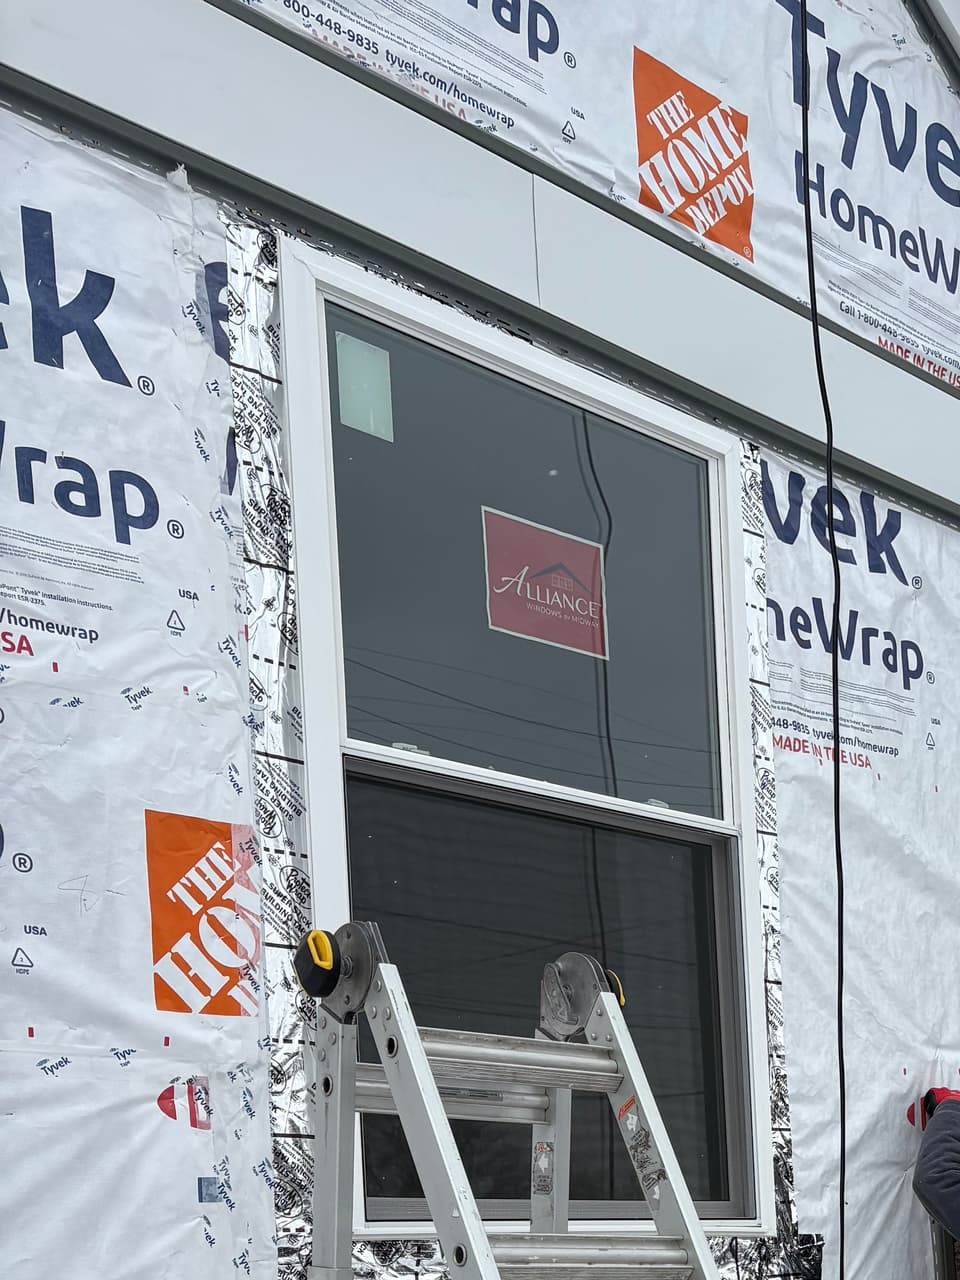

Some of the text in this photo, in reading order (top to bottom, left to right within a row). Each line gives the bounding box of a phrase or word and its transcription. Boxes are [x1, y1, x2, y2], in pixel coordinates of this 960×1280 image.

[385, 49, 515, 128] tyvek.com/homewrap
[646, 90, 694, 140] THE
[637, 102, 750, 214] HOME
[684, 165, 755, 236] DEPOT
[839, 301, 856, 318] Call
[912, 354, 924, 369] IN
[215, 507, 234, 538] Tyvek
[178, 588, 200, 601] USA
[493, 566, 602, 619] ALLIANCE
[222, 638, 241, 669] Tyvek
[125, 686, 152, 705] Tyvek
[772, 734, 810, 755] MADE
[824, 747, 848, 763] TE
[849, 751, 872, 770] USA
[245, 837, 263, 867] Tyvek
[166, 840, 241, 916] THE
[269, 883, 293, 908] SUPER
[24, 924, 47, 936] USA
[242, 965, 261, 993] Tyvek
[41, 1056, 72, 1076] Tyvek
[194, 1088, 214, 1117] Tyvek
[258, 1161, 277, 1191] Tyvek
[218, 1184, 236, 1212] Tyvek
